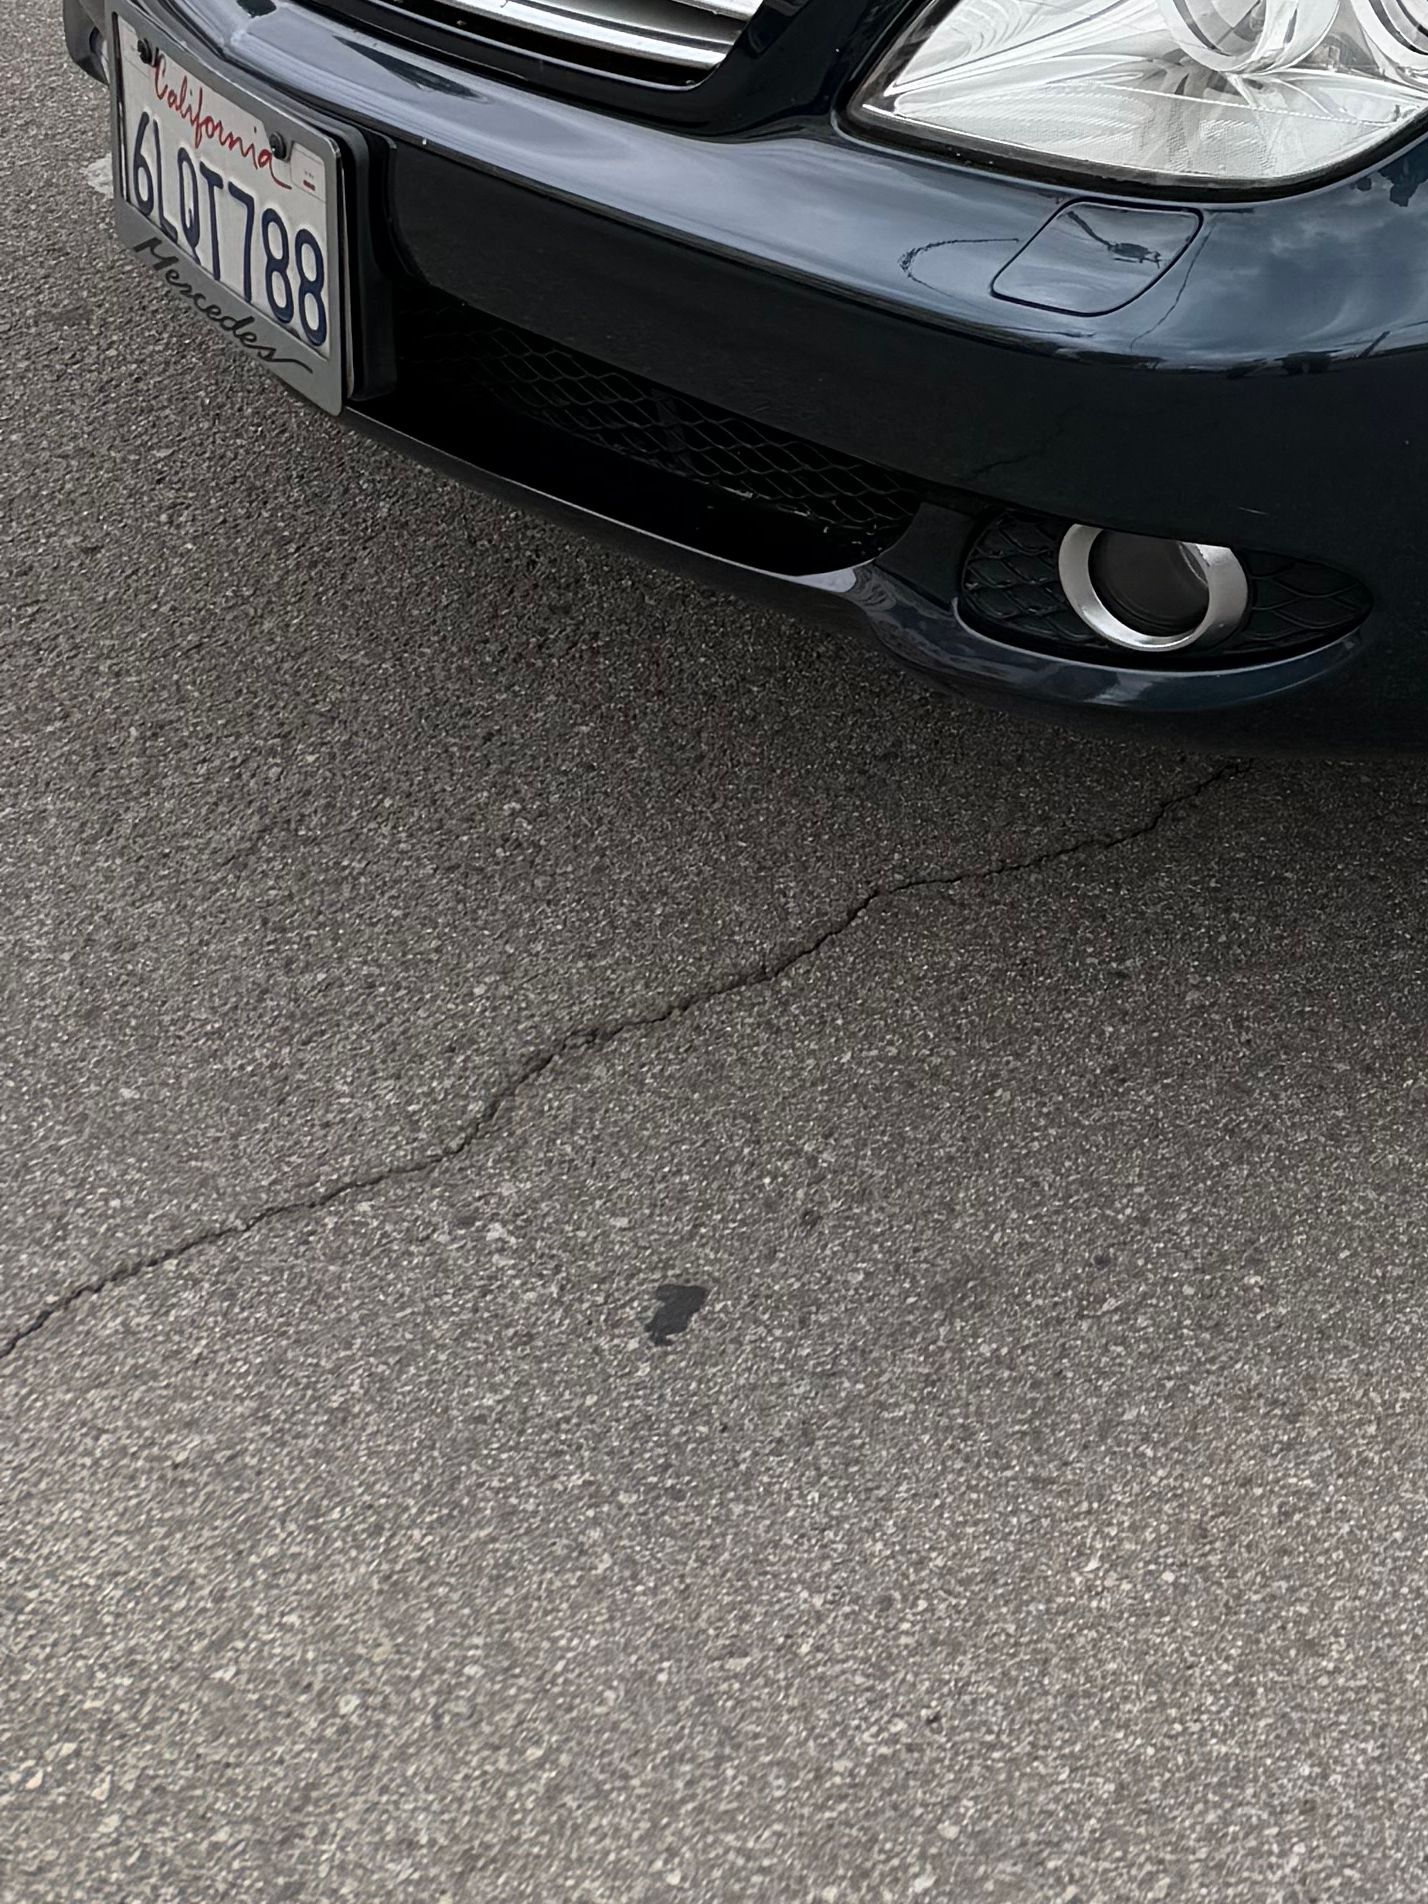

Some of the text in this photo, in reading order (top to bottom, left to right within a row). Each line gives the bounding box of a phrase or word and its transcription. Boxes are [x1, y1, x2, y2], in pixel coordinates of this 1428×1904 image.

[152, 49, 291, 190] California
[132, 111, 328, 347] 6LQT788
[133, 237, 314, 374] Mercedes
